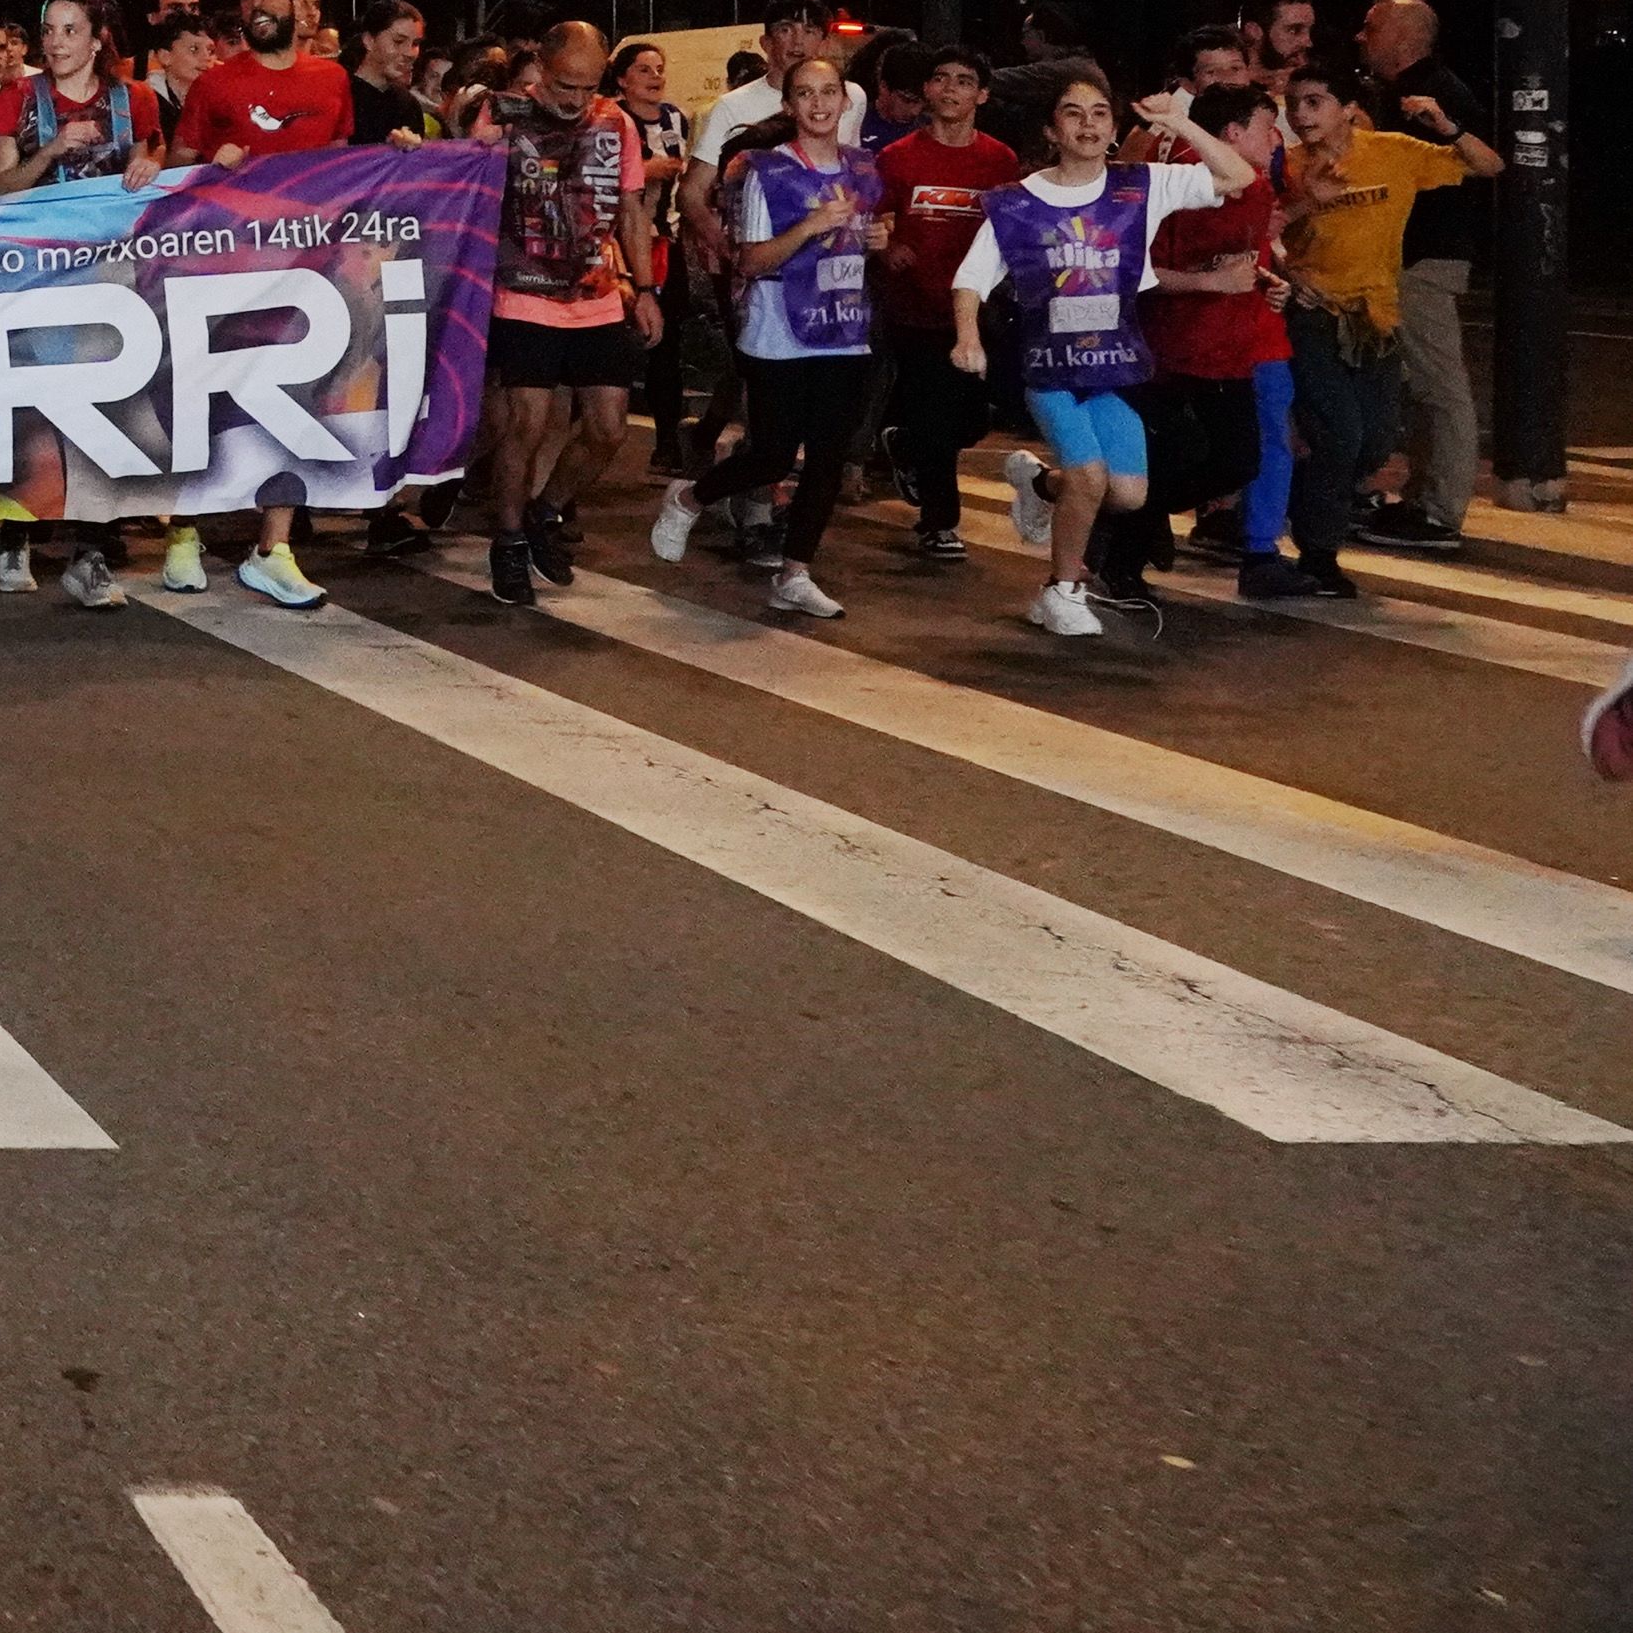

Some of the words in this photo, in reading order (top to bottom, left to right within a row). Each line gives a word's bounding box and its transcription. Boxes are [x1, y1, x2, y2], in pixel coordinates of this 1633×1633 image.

[37, 228, 235, 272] martxoaren
[247, 214, 332, 251] 14tik
[341, 211, 421, 244] 24ra
